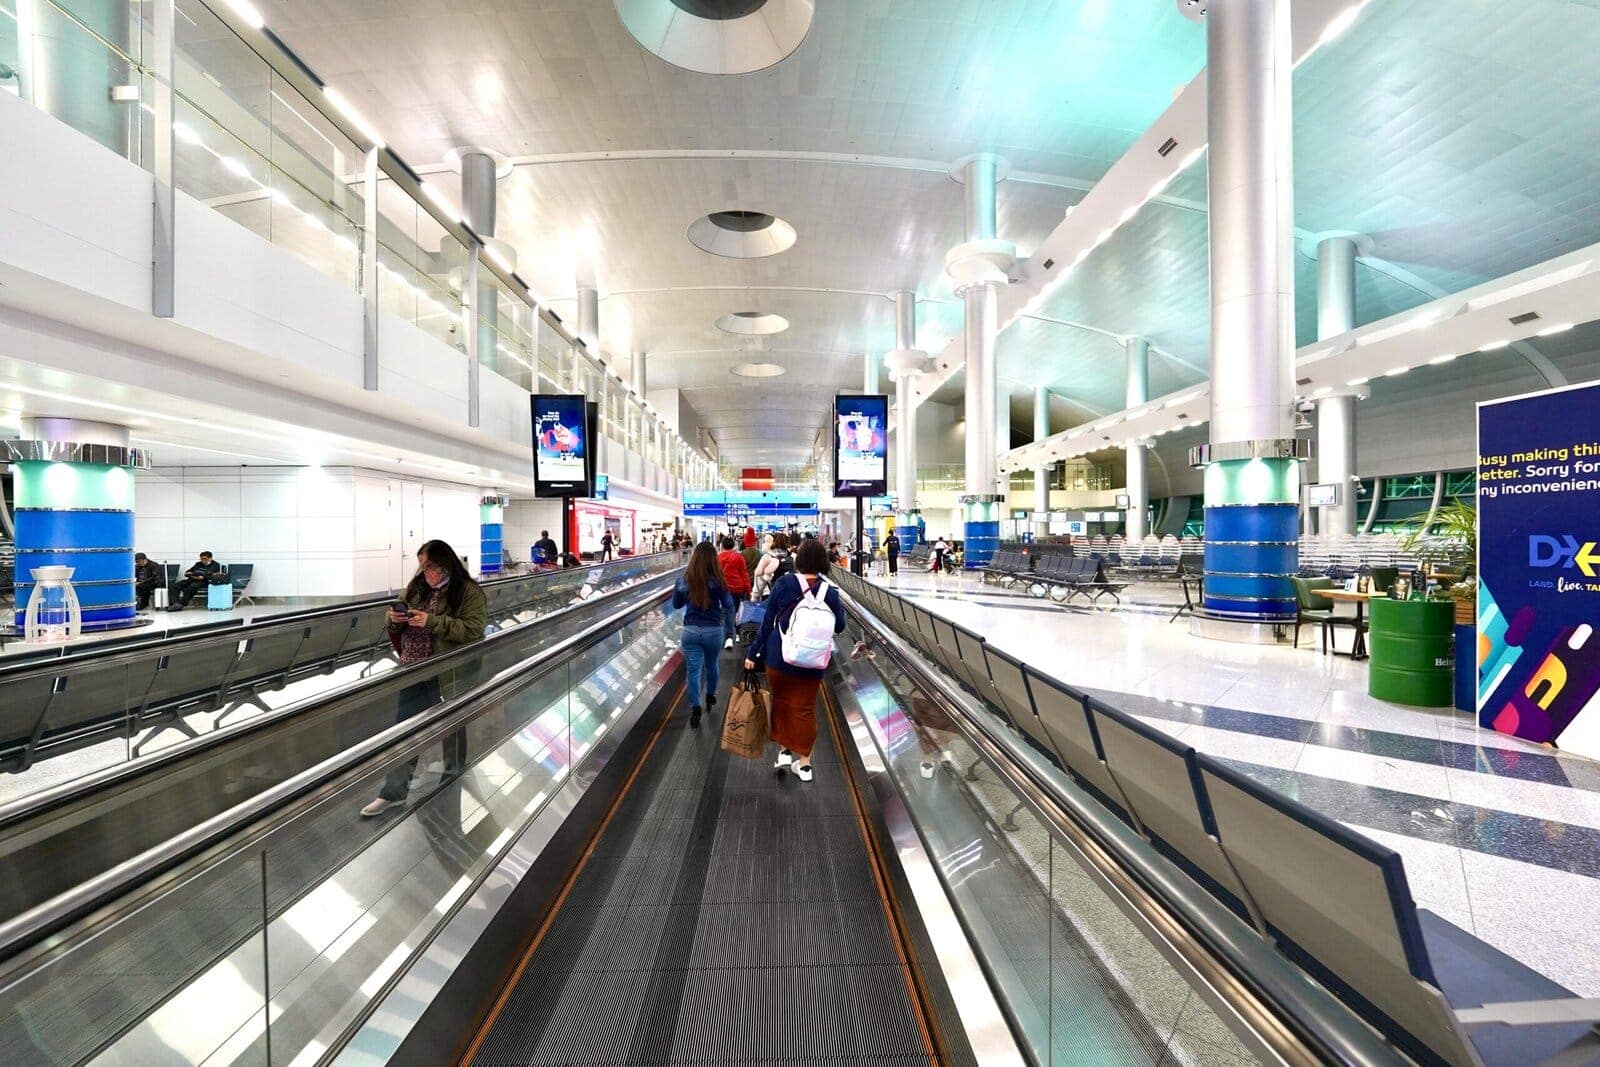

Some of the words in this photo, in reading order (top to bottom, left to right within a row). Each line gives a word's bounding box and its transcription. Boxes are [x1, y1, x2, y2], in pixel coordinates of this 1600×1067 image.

[1511, 447, 1569, 463] making
[1573, 442, 1600, 457] thi
[1526, 465, 1569, 478] Sorry
[1574, 460, 1600, 474] for
[1478, 486, 1498, 498] ny
